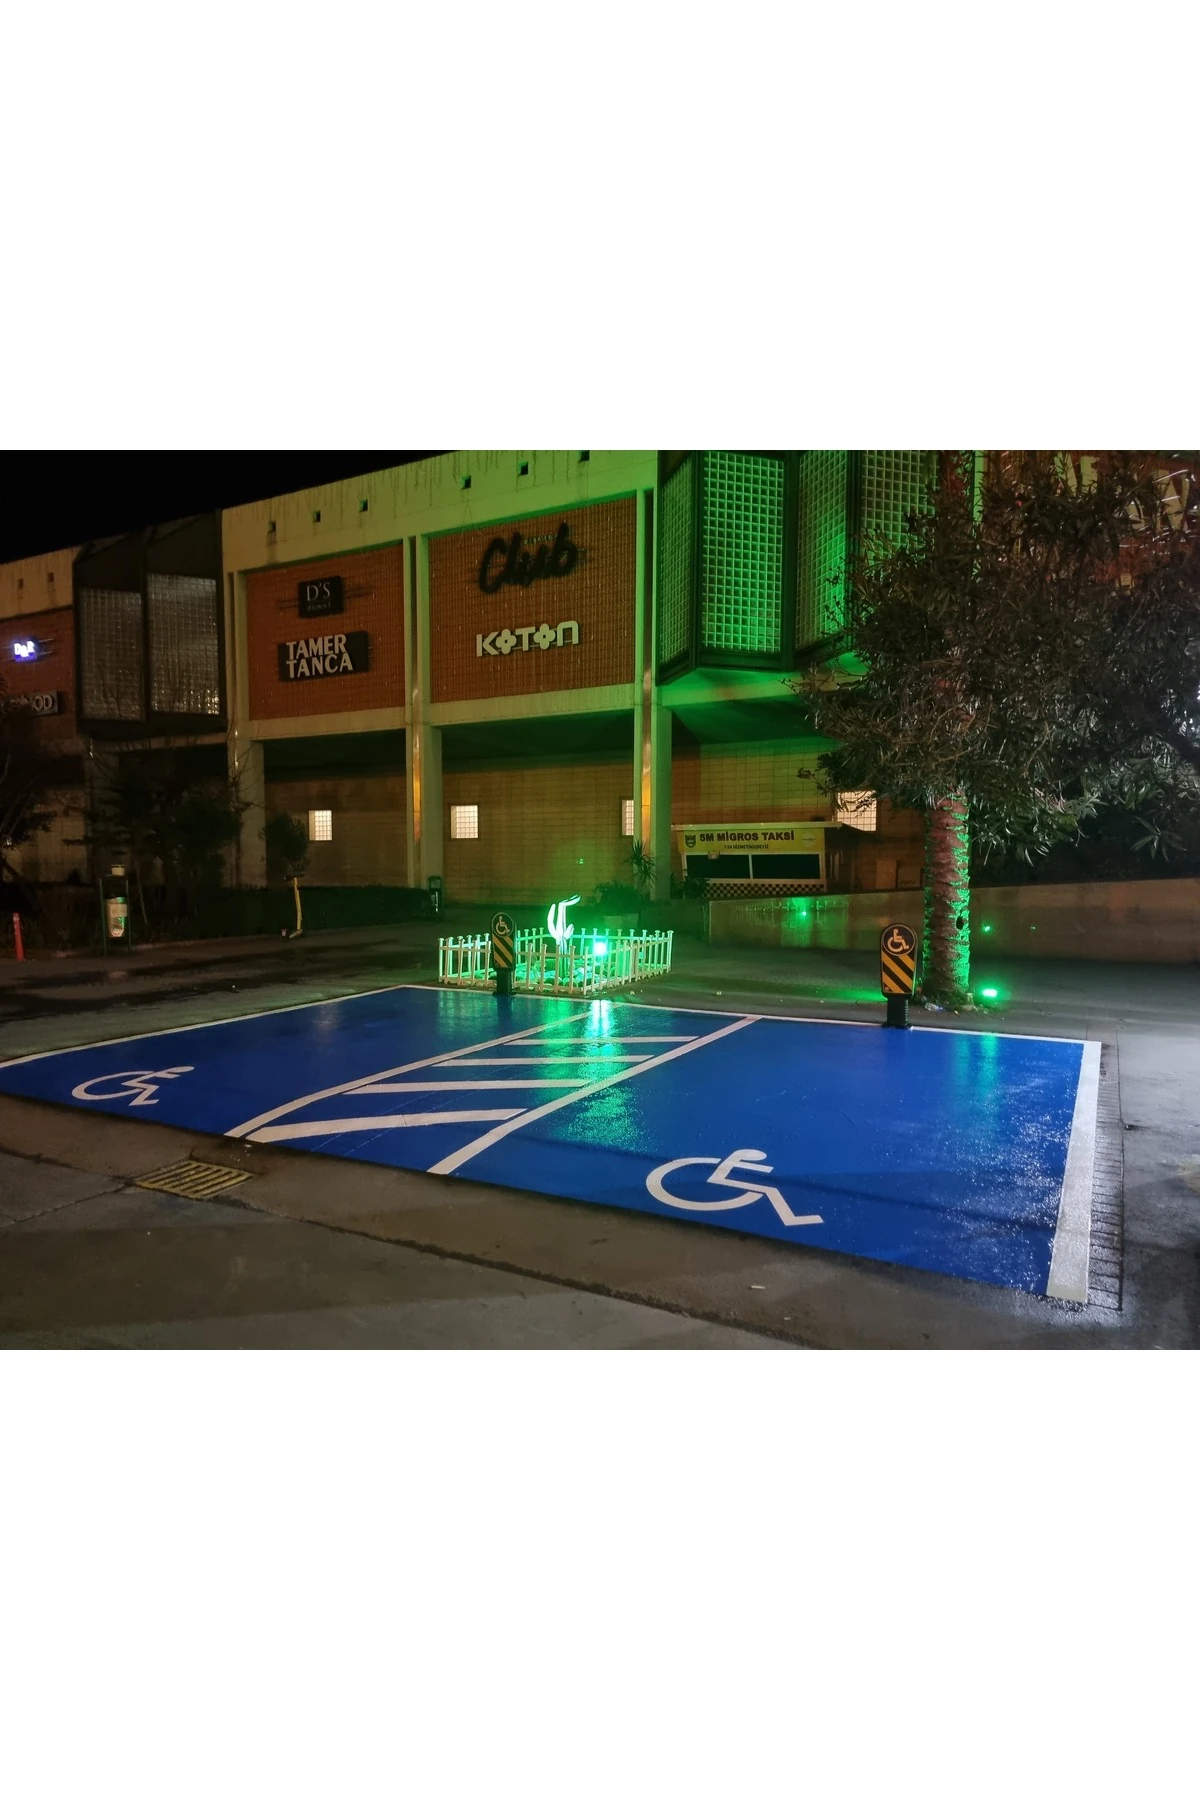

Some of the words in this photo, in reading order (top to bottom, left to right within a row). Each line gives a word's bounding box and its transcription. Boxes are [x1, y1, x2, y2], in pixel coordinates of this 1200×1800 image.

[479, 521, 577, 594] Club
[306, 582, 331, 602] D'S
[286, 634, 347, 661] TAMER
[286, 652, 354, 679] TANCA
[700, 833, 714, 842] 5M
[717, 831, 759, 842] MİGROS
[761, 830, 795, 841] TAKSİ
